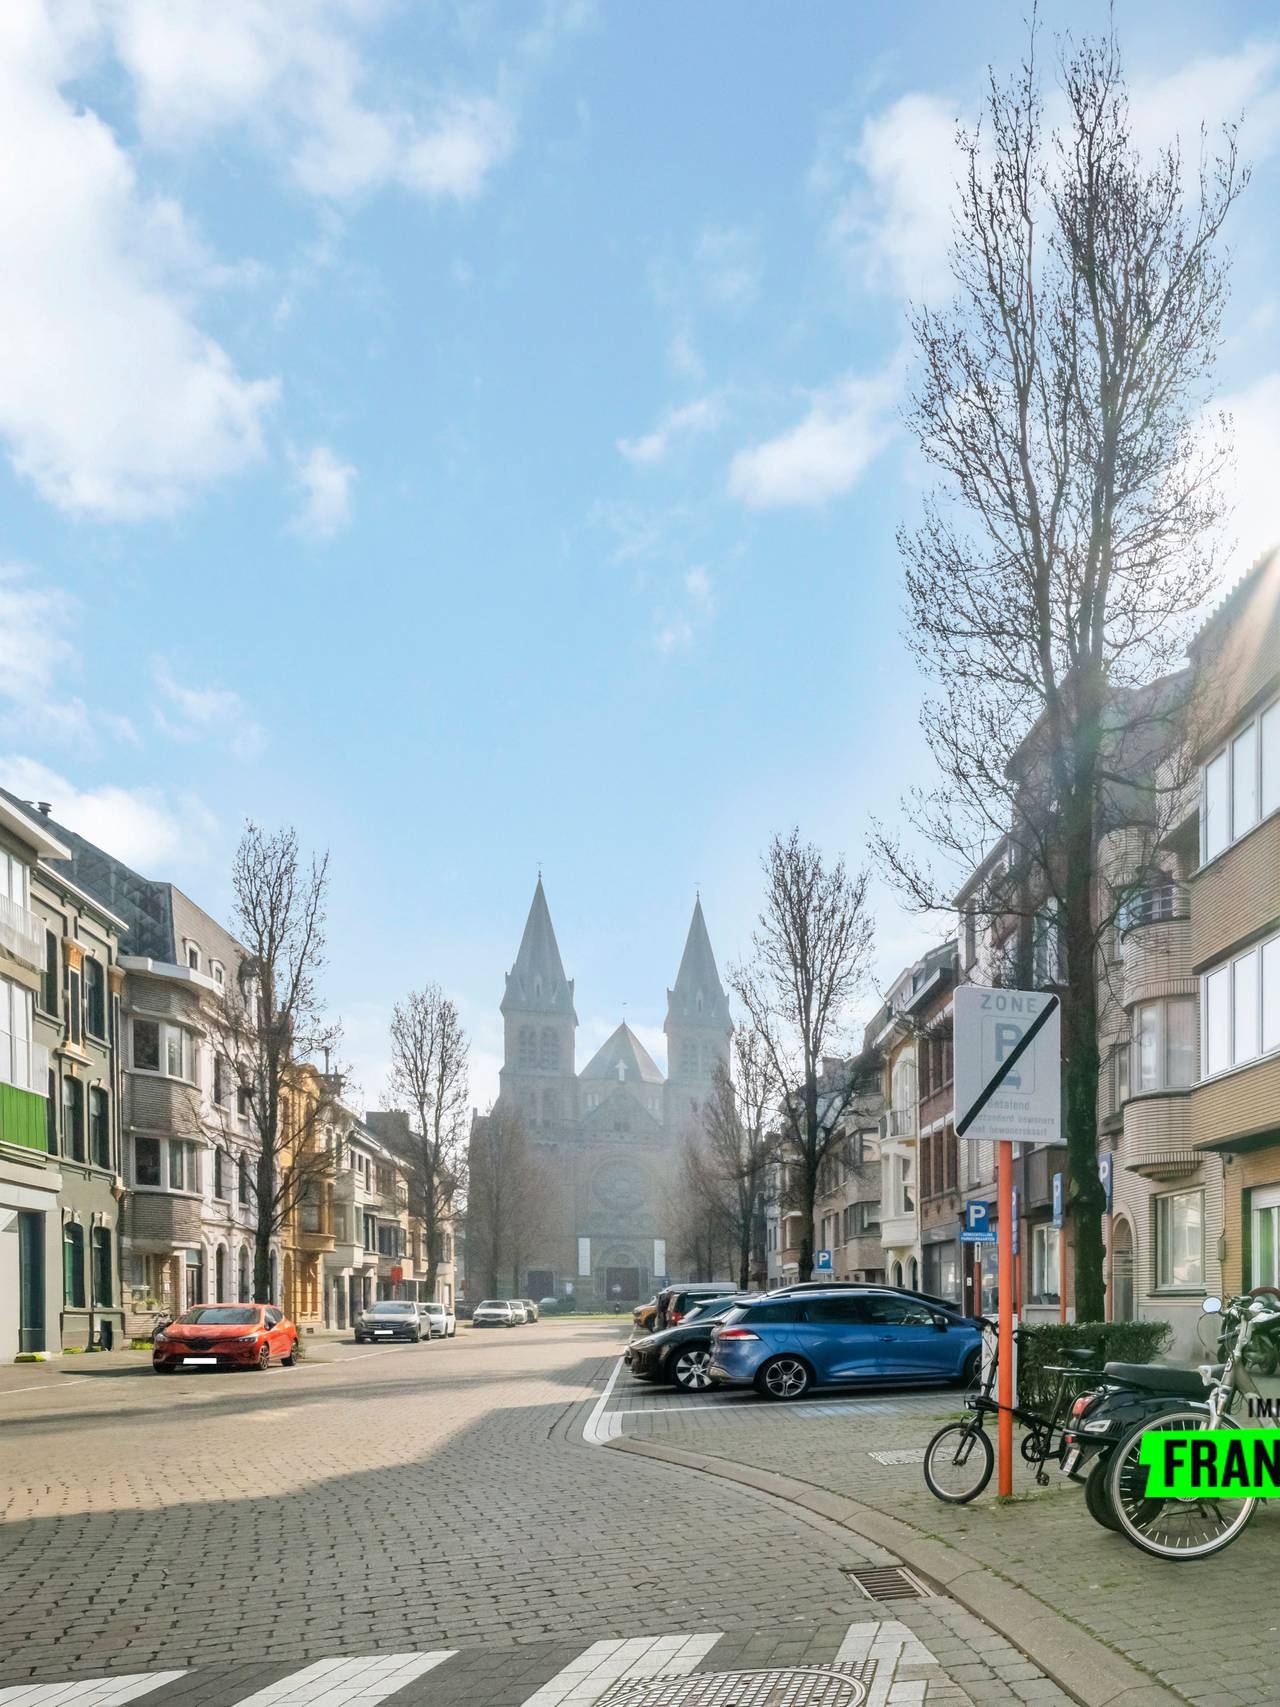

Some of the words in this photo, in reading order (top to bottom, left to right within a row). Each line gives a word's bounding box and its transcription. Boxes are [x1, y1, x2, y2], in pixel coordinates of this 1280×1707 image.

[980, 994, 1039, 1014] ZONE
[995, 1023, 1024, 1062] P
[970, 1205, 986, 1227] P
[819, 1252, 829, 1265] P
